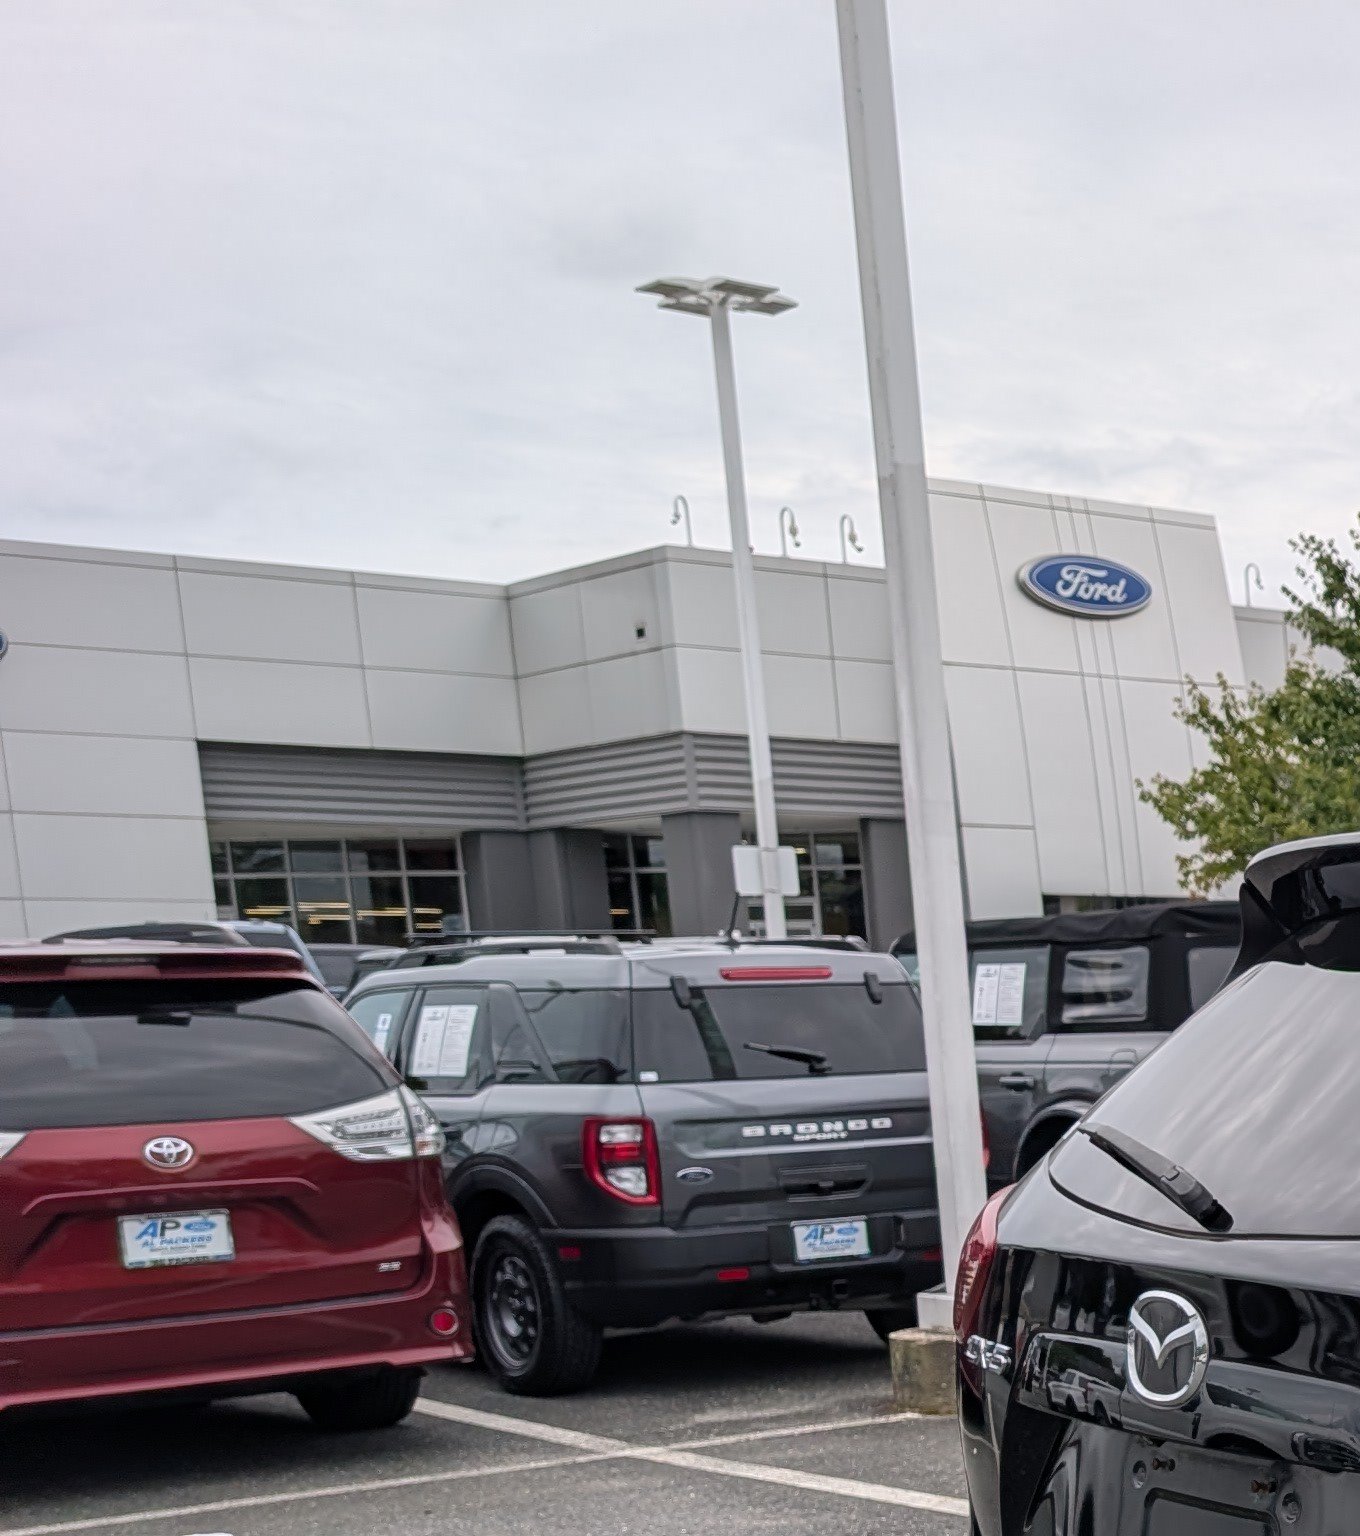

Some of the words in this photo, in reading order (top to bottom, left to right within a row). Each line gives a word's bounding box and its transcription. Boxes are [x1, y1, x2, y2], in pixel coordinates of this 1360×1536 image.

[1055, 564, 1128, 603] Ford
[742, 1117, 893, 1138] BRONCO
[792, 1130, 849, 1142] SPORT
[135, 1219, 182, 1241] AP
